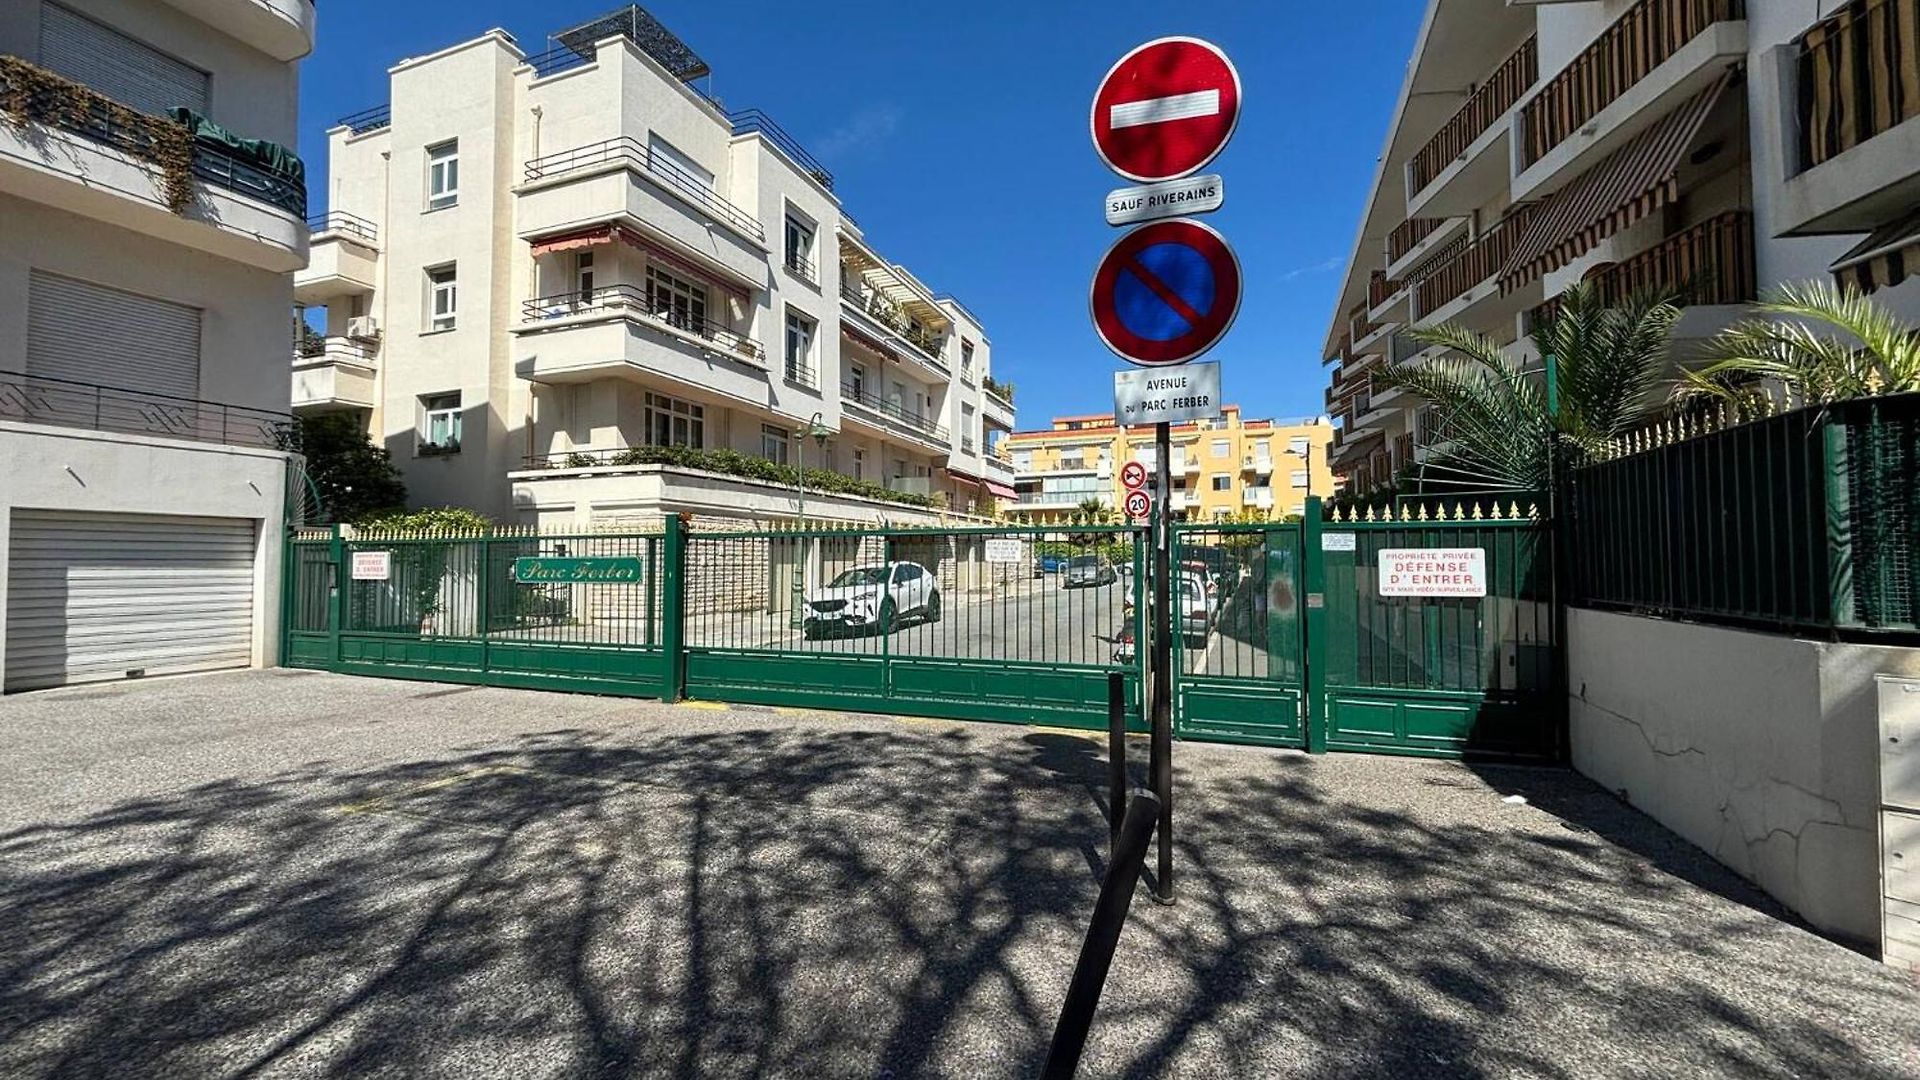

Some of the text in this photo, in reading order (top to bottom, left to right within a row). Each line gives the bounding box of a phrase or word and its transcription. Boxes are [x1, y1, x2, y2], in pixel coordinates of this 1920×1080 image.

[1112, 187, 1215, 212] SAUF RIVERAINS
[1146, 377, 1187, 391] AVENUE
[1125, 395, 1209, 413] DU PARC FERBER
[1131, 498, 1145, 511] 20
[522, 561, 633, 579] Parc Ferber
[1395, 561, 1467, 572] DÉFENSE
